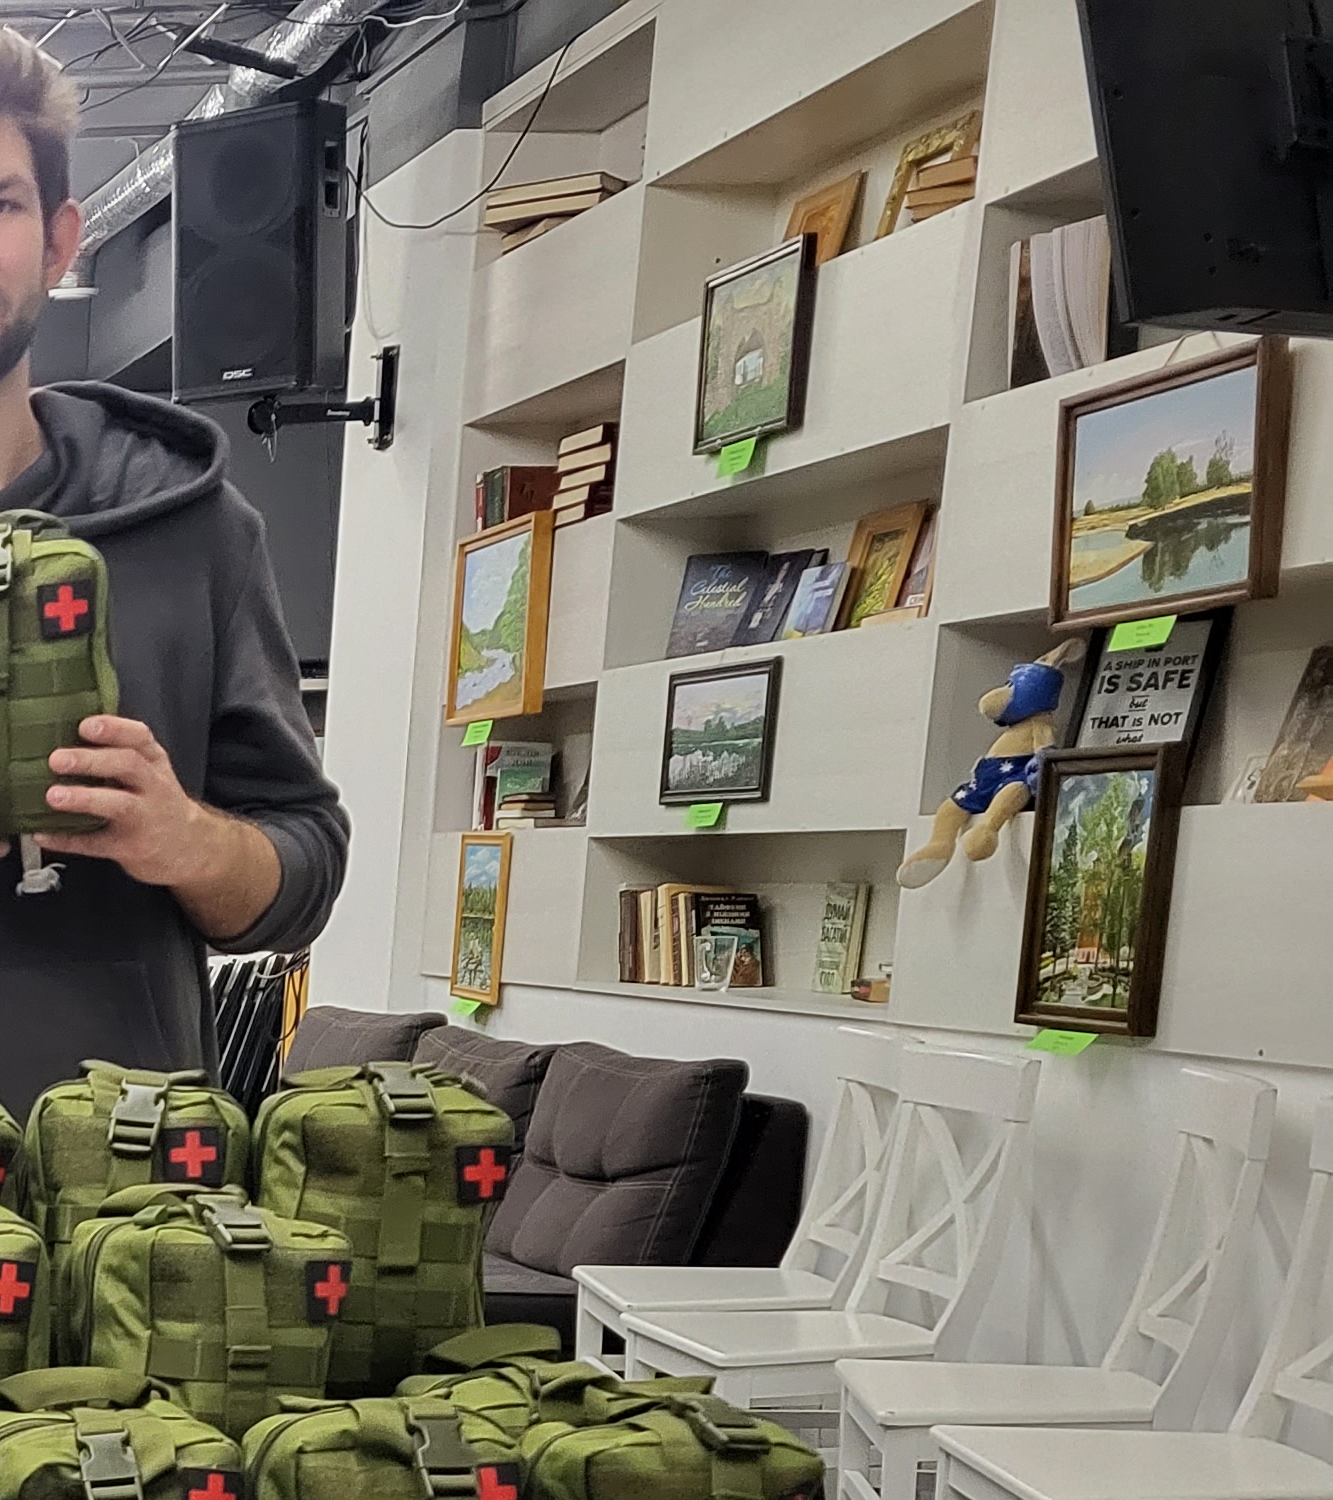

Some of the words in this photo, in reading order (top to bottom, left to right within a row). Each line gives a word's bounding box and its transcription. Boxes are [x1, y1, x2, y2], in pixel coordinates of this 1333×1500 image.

[223, 368, 252, 381] QSC
[1103, 661, 1113, 671] A
[1114, 659, 1145, 671] SHIP
[1147, 657, 1161, 669] IN
[1163, 654, 1200, 667] PORT
[1097, 674, 1122, 694] IS
[1126, 668, 1195, 692] SAFE
[1129, 699, 1149, 708] but
[1090, 715, 1129, 729] THAT
[1131, 717, 1144, 727] IS
[1148, 711, 1183, 726] NOT
